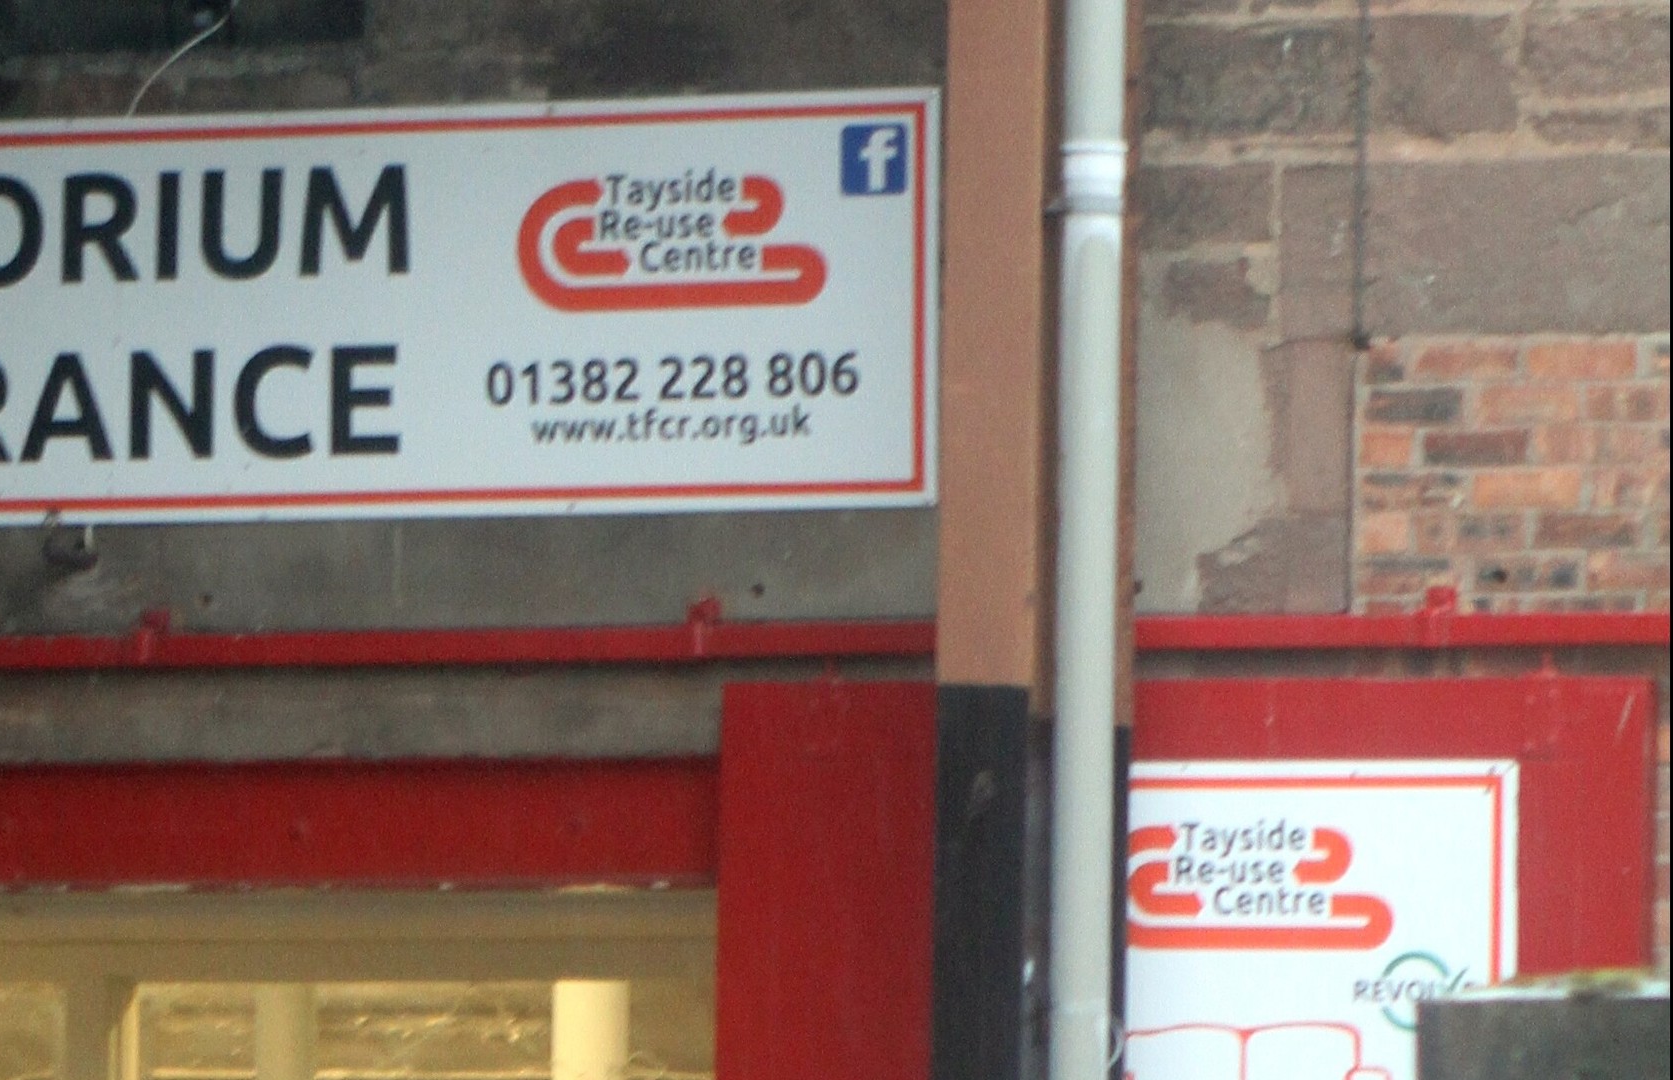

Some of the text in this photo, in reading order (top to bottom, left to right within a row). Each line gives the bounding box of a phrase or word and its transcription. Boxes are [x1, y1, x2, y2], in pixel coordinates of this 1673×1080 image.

[605, 166, 738, 212] Tayside
[598, 210, 716, 242] Re-use
[638, 241, 758, 273] Centre
[486, 350, 861, 407] 01382 228 806
[530, 404, 813, 445] www.tfcr.org.uk
[1179, 818, 1307, 858] Tayside
[1174, 856, 1287, 886] Re-use
[1213, 885, 1327, 918] Centre
